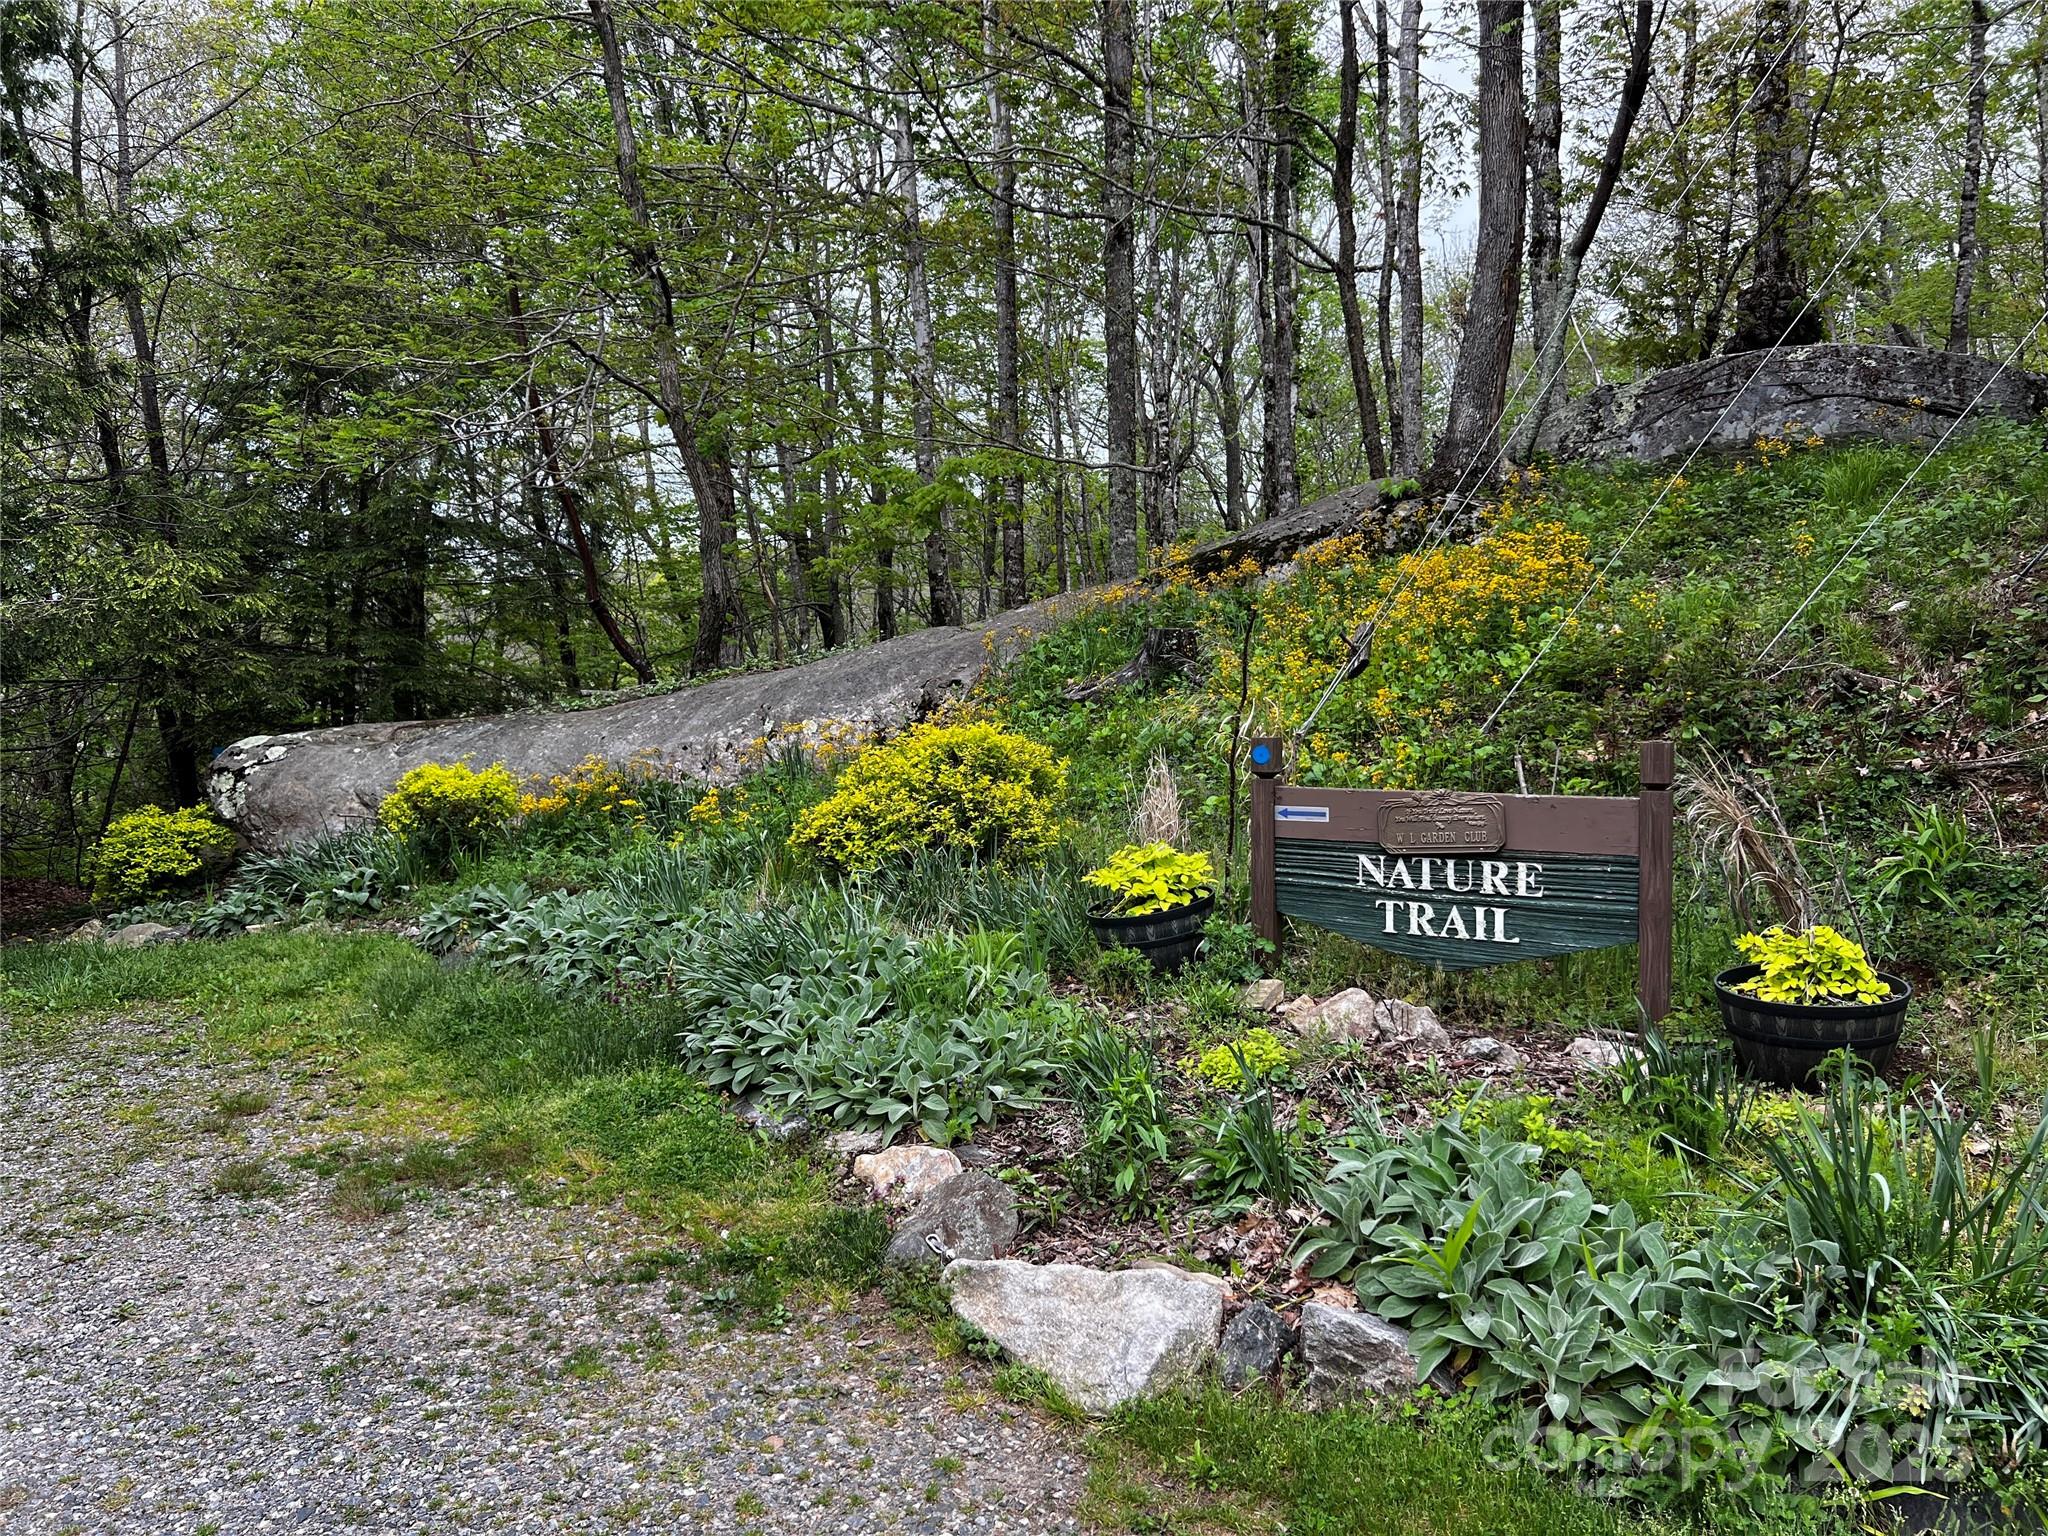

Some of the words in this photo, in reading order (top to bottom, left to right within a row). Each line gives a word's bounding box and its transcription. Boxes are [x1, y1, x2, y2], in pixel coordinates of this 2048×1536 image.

[1396, 832, 1403, 843] W
[1410, 833, 1416, 843] L
[1420, 832, 1456, 843] GARDEN
[1464, 831, 1488, 842] CLUB
[1356, 854, 1544, 897] NATURE
[1375, 900, 1520, 943] TRAIL
